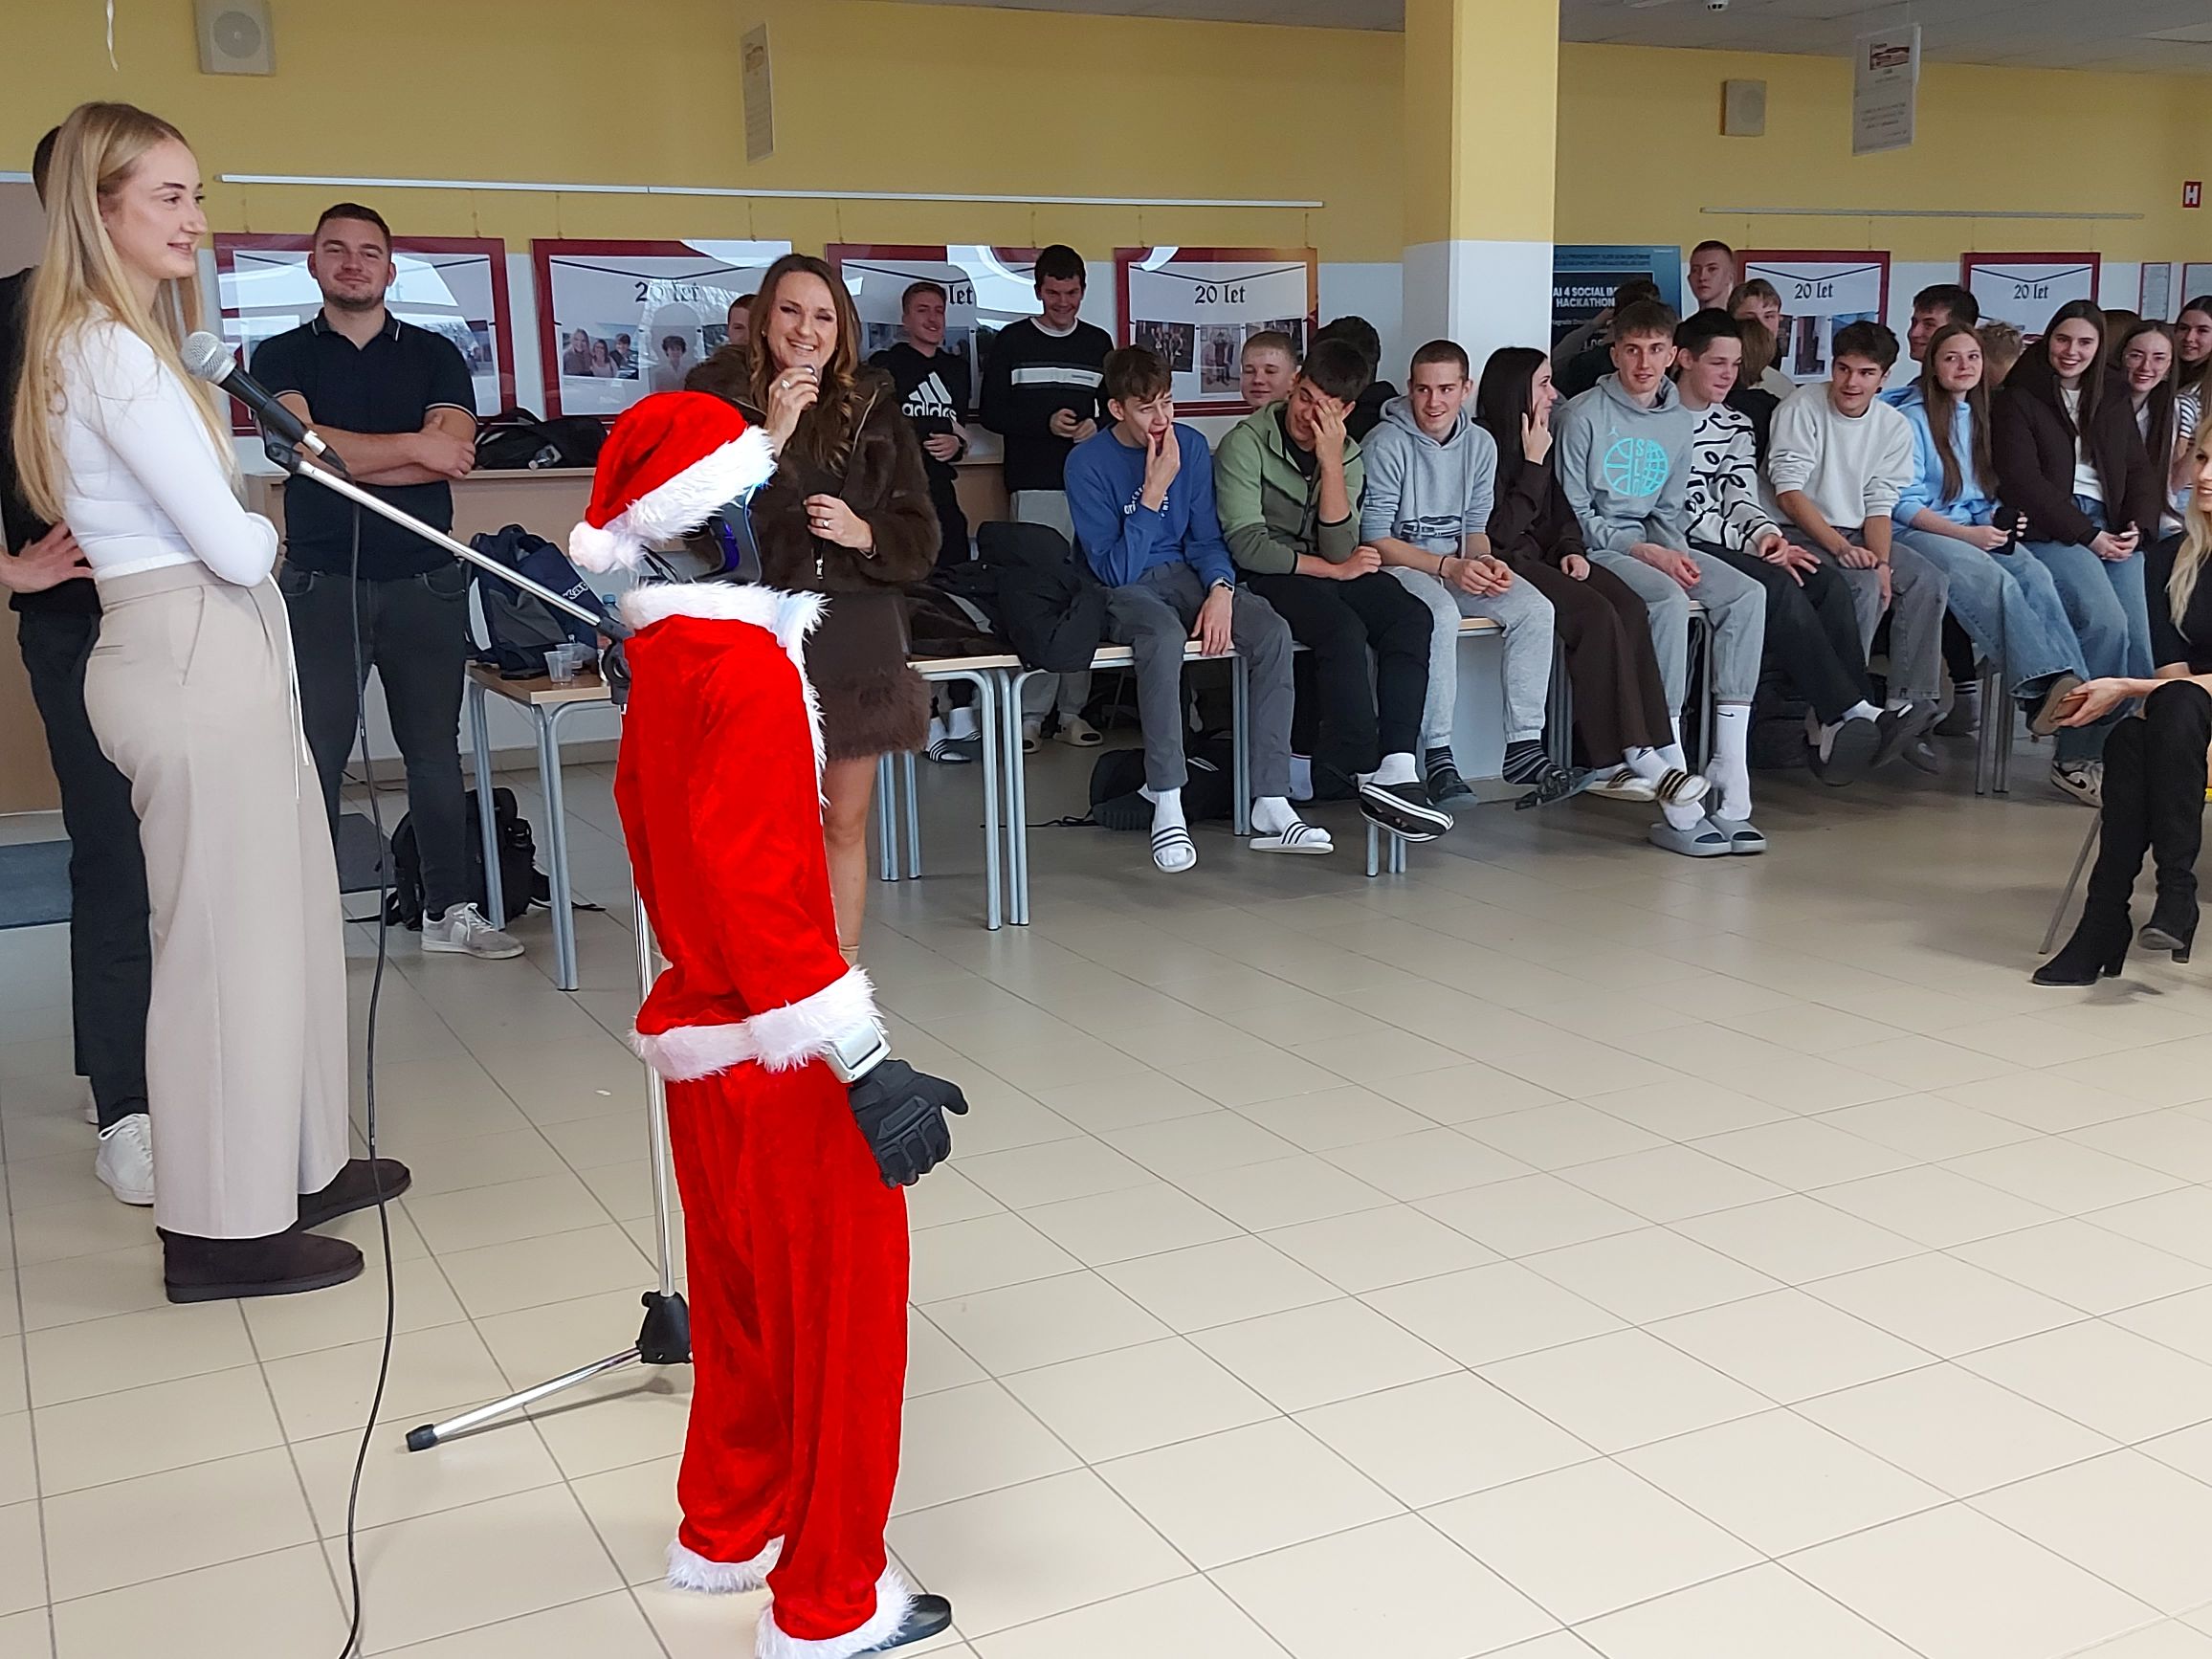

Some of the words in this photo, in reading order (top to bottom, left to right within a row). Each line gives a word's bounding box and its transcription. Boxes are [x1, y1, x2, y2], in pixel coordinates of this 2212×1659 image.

[2185, 185, 2199, 205] H
[948, 285, 973, 304] let
[1194, 284, 1218, 304] 20
[1224, 283, 1246, 303] let
[1553, 287, 1562, 297] AI
[1563, 287, 1570, 296] 4
[1572, 287, 1605, 297] SOCIAL
[1794, 282, 1812, 299] 20
[1816, 281, 1833, 299] let
[2013, 283, 2029, 299] 20
[2033, 283, 2049, 299] let
[1556, 298, 1616, 307] HACKATHON
